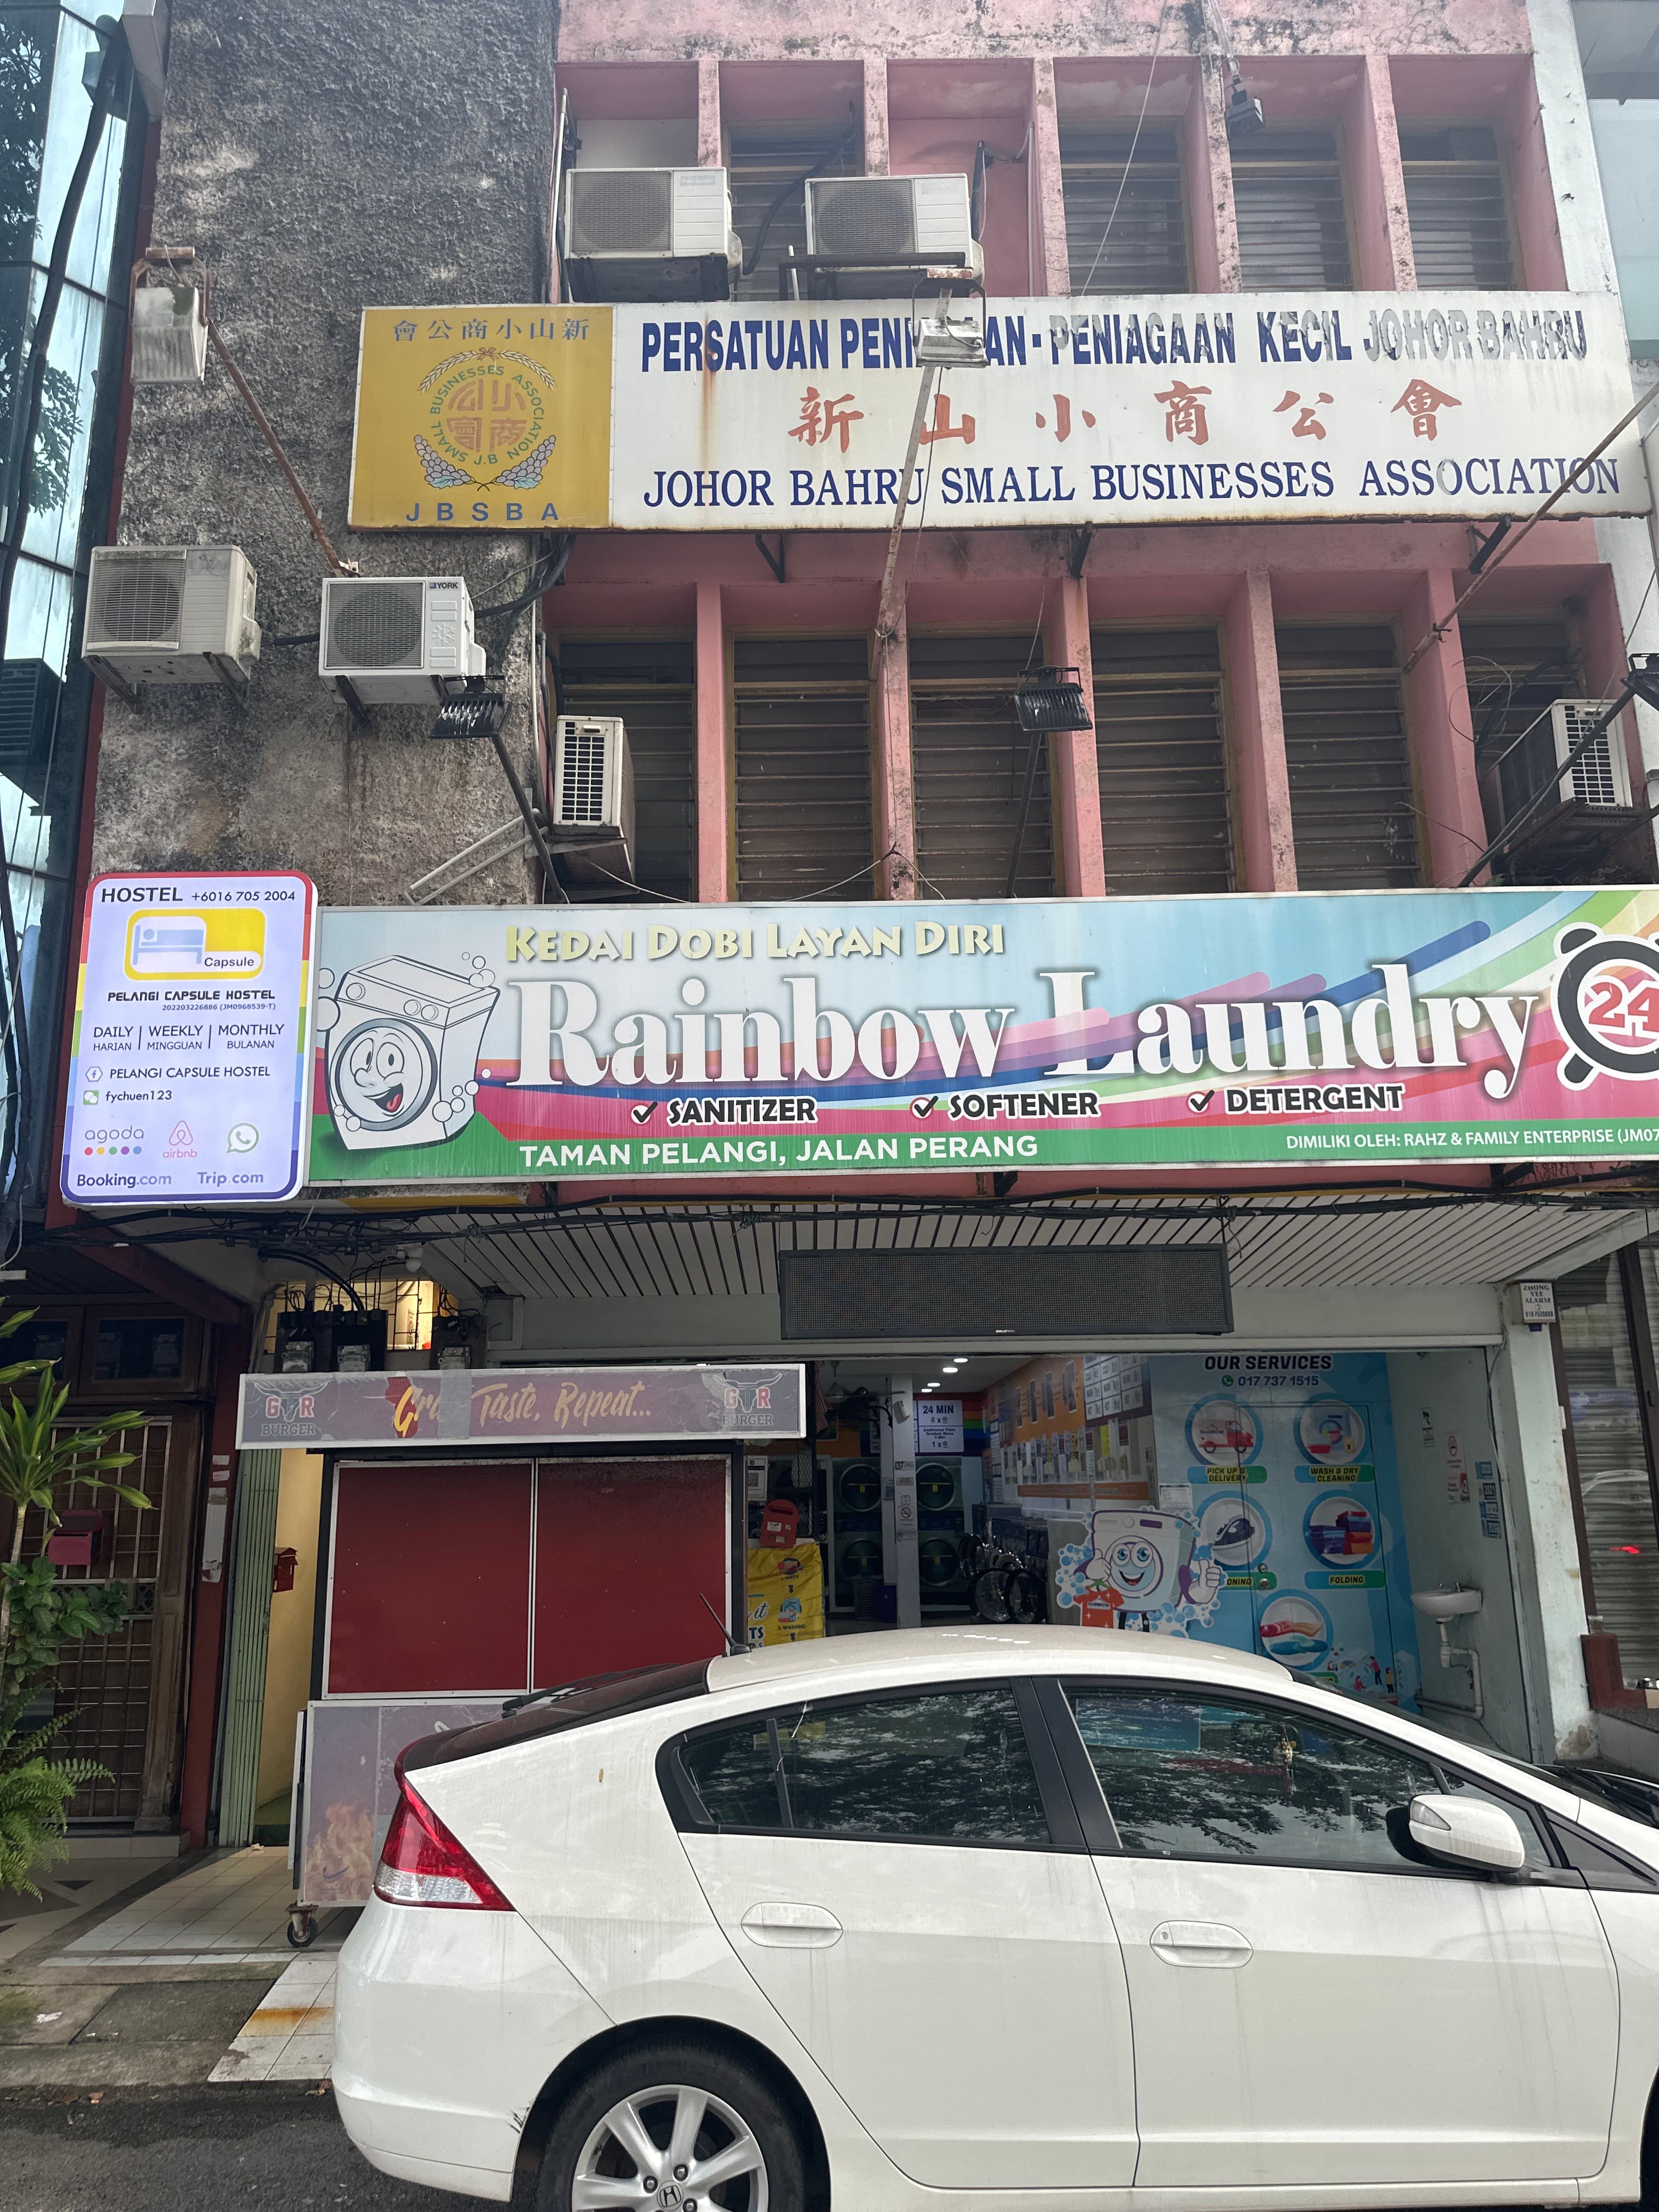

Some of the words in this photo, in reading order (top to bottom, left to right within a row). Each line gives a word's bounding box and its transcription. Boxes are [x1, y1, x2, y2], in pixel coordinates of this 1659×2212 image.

[642, 318, 828, 373] PERSATUAN
[1259, 310, 1352, 363] KECIL
[1364, 308, 1471, 362] JOHOR
[1475, 309, 1587, 360] BAHRU
[430, 365, 504, 414] BUSINESSES
[506, 374, 544, 459] ASSOCIATION
[431, 421, 468, 462] SMALL
[474, 454, 498, 465] J.B
[644, 470, 773, 508] JOHOR
[791, 469, 924, 506] BAHRU
[941, 465, 1076, 505] SMALL
[1091, 461, 1335, 500] BUSINESSES
[1359, 458, 1620, 496] ASSOCIATION
[101, 887, 183, 902] HOSTEL
[191, 890, 232, 902] +6016
[236, 890, 259, 901] 705
[264, 890, 295, 901] 2004
[505, 924, 634, 963] KEDAI
[648, 924, 753, 961] DOBI
[769, 923, 900, 960] LAYAN
[915, 921, 1005, 956] DIRI
[204, 957, 255, 969] Capsule
[108, 991, 159, 1002] PELANGI
[165, 991, 221, 1001] CAPSULE
[226, 989, 275, 1000] HOSTEL
[93, 1026, 134, 1038] DAILY
[149, 1024, 203, 1037] WEEKLY
[218, 1023, 285, 1036] MONTHLY
[506, 976, 1014, 1086] Rainbow
[1039, 963, 1538, 1099] Laundry
[93, 1042, 132, 1052] HARIAN
[147, 1041, 202, 1051] MINGGUAN
[227, 1040, 275, 1049] BULANAN
[110, 1068, 162, 1080] PELANGI
[166, 1067, 220, 1079] CAPSULE
[224, 1066, 270, 1077] HOSTEL
[106, 1090, 172, 1104] fychuen123
[668, 1097, 817, 1125] SANITIZER
[947, 1091, 1099, 1121] SOFTENER
[1227, 1084, 1405, 1113] DETERGENT
[84, 1125, 144, 1144] agoda
[1286, 1135, 1350, 1149] DIMILIKI
[1354, 1133, 1400, 1148] OLEH:
[1404, 1132, 1447, 1146] RAHZ
[1451, 1132, 1462, 1145] &
[1465, 1131, 1520, 1145] FAMILY
[1523, 1129, 1614, 1144] ENTERPRISE
[163, 1148, 198, 1159] airbnb
[520, 1144, 630, 1168] TAMAN
[643, 1141, 785, 1167] PELANGI,
[795, 1138, 899, 1161] JALAN
[910, 1135, 1038, 1159] PERANG
[77, 1173, 172, 1189] Booking.com
[198, 1171, 264, 1188] Trip.com
[1205, 1356, 1240, 1370] OUR
[1245, 1355, 1332, 1370] SERVICES
[1238, 1375, 1260, 1386] 017
[1263, 1375, 1286, 1386] 737
[1290, 1375, 1319, 1386] 1515
[923, 1406, 933, 1414] 24
[936, 1405, 954, 1414] MIN
[721, 1413, 774, 1426] BURGER
[261, 1423, 316, 1436] BURGER
[1329, 1576, 1364, 1584] FOLDING
